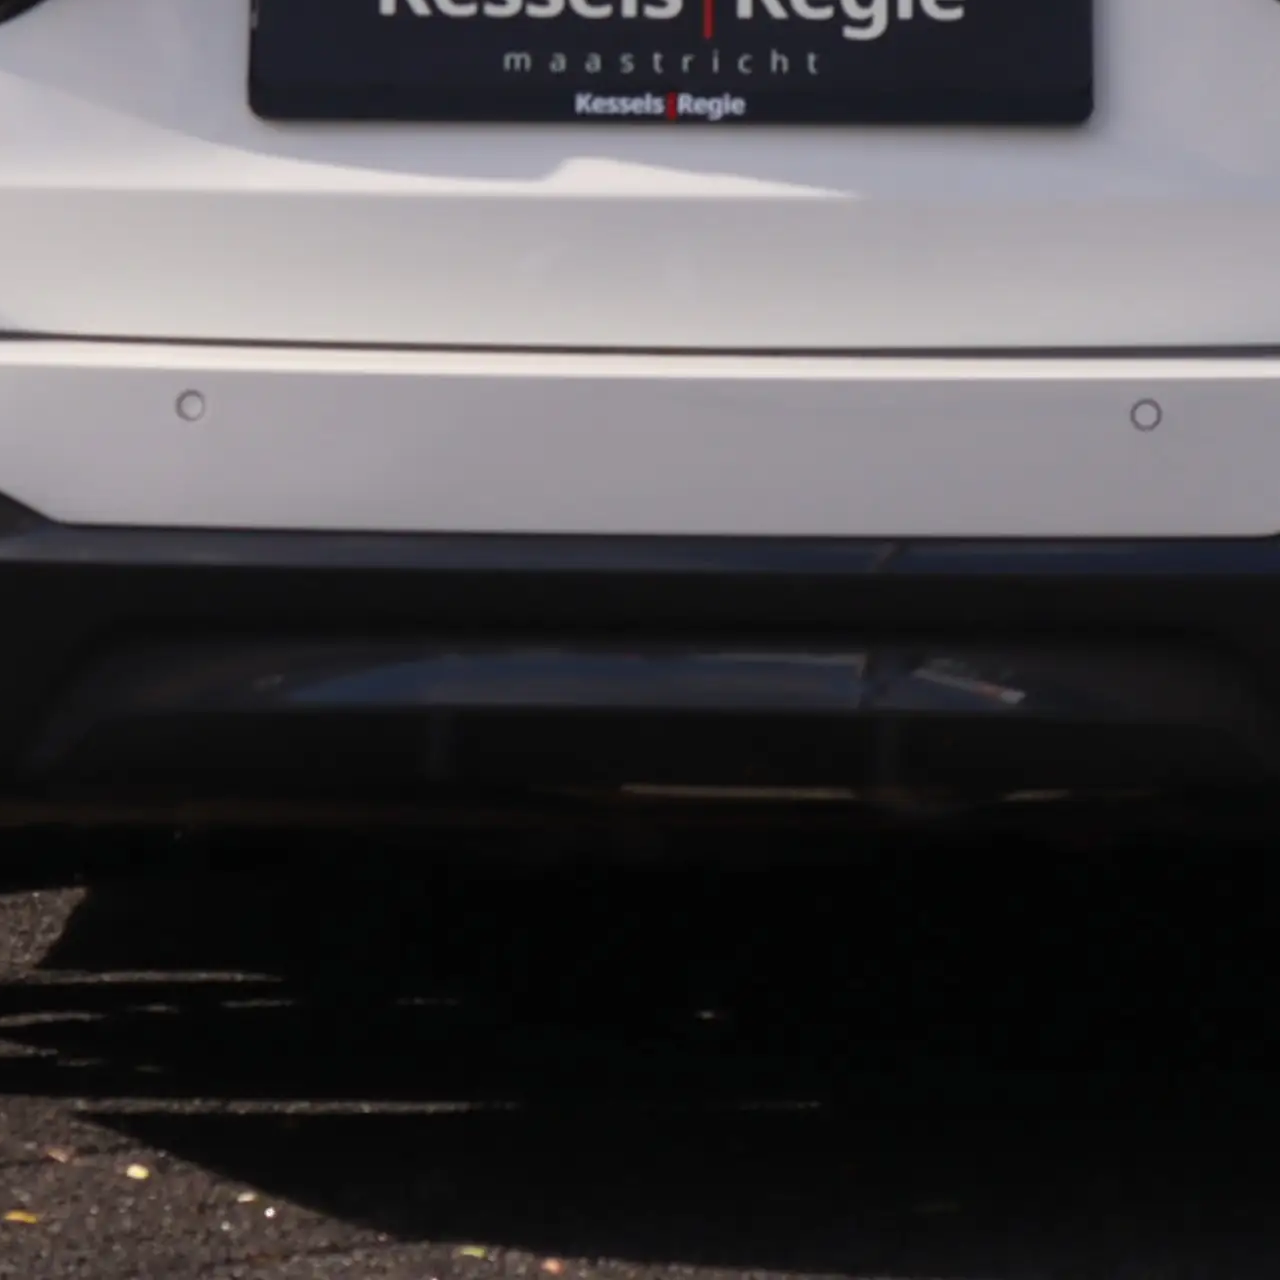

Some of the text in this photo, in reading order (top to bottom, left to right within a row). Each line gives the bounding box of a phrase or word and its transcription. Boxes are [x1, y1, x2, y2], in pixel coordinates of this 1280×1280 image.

[503, 49, 820, 75] maastricht
[574, 91, 747, 120] Kessels Regie
